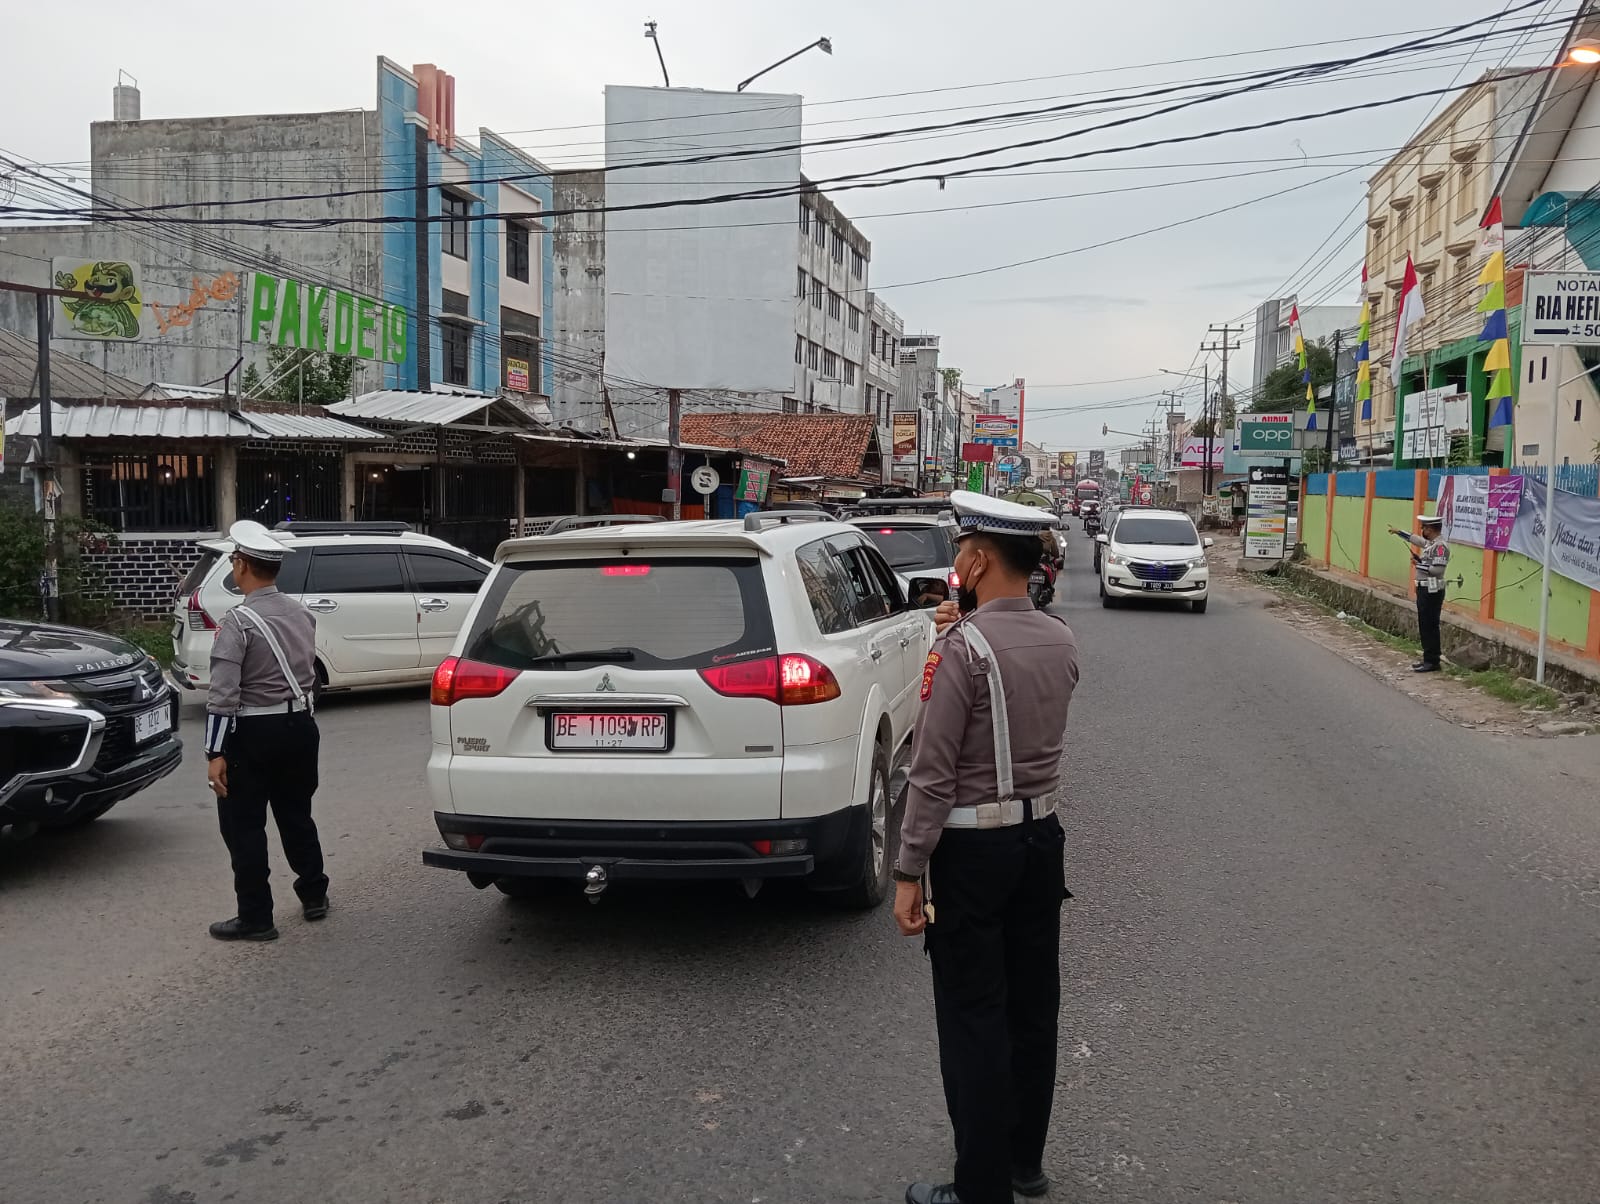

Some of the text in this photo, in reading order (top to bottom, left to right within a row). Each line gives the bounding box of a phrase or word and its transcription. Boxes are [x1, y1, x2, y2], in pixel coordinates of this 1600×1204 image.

[1535, 295, 1600, 321] RIA HEFI
[1252, 430, 1293, 442] opp
[1551, 522, 1578, 549] Natal
[1577, 535, 1595, 556] dan
[556, 716, 577, 736] BE
